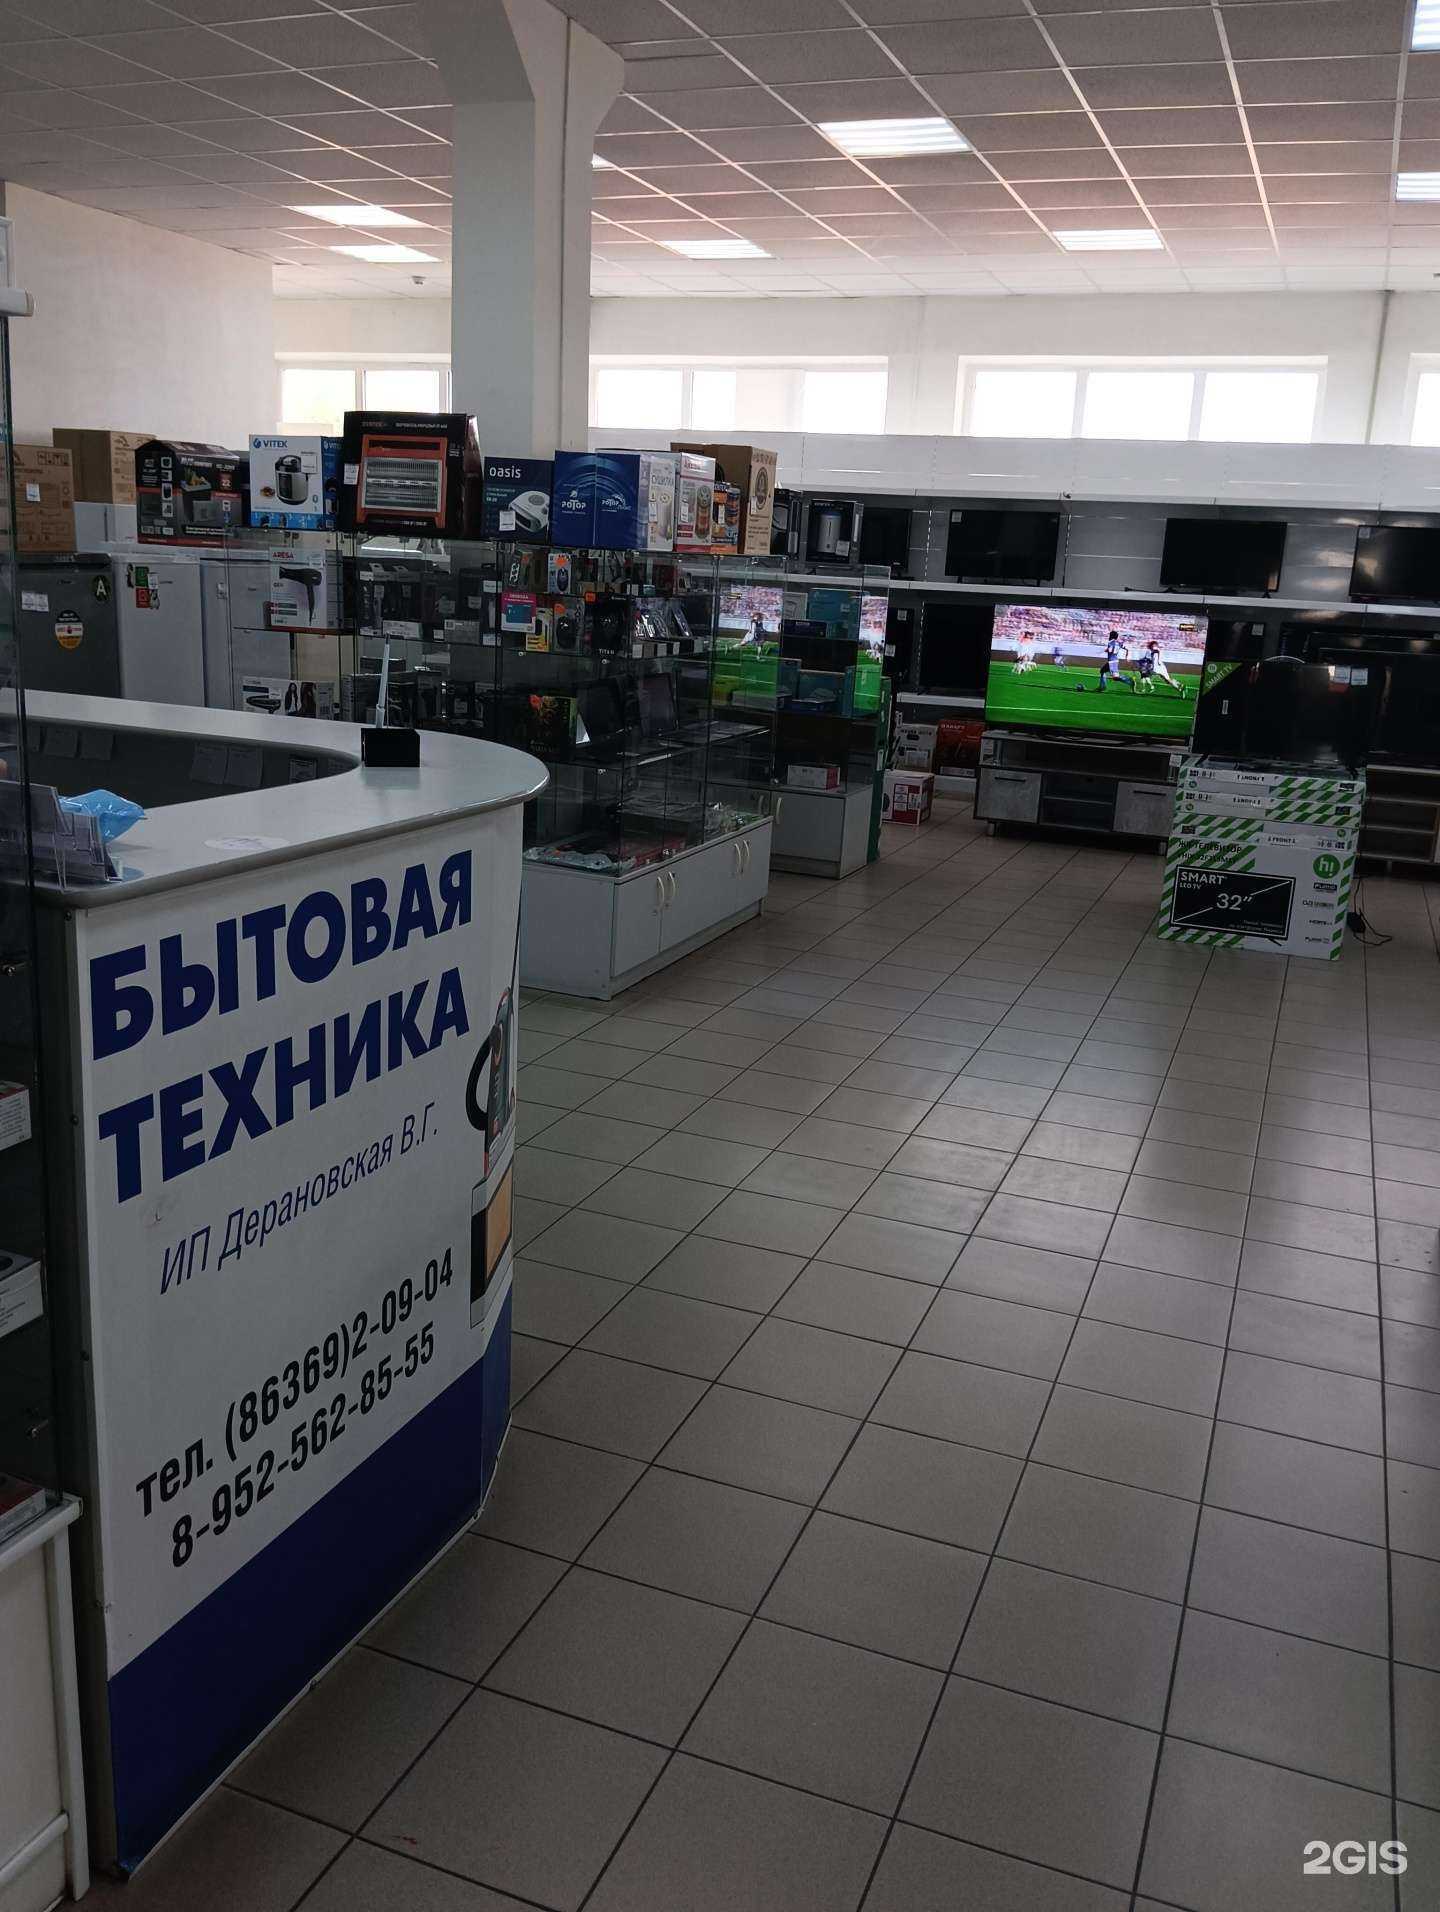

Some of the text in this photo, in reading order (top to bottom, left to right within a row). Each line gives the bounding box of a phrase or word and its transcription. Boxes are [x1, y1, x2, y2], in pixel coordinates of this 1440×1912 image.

[263, 439, 288, 449] VITEK
[489, 465, 522, 479] oasis
[272, 551, 294, 559] ARESA
[1207, 671, 1225, 689] SMART
[1181, 871, 1225, 885] SMART
[90, 850, 472, 1060] БЫТОВАЯ
[99, 967, 470, 1203] ТЕХНИКА
[160, 1102, 438, 1295] ИП Дерановская В.Г.
[136, 1248, 453, 1518] тел. (86369)2-09-04
[172, 1321, 434, 1568] 8-952-562-85-55
